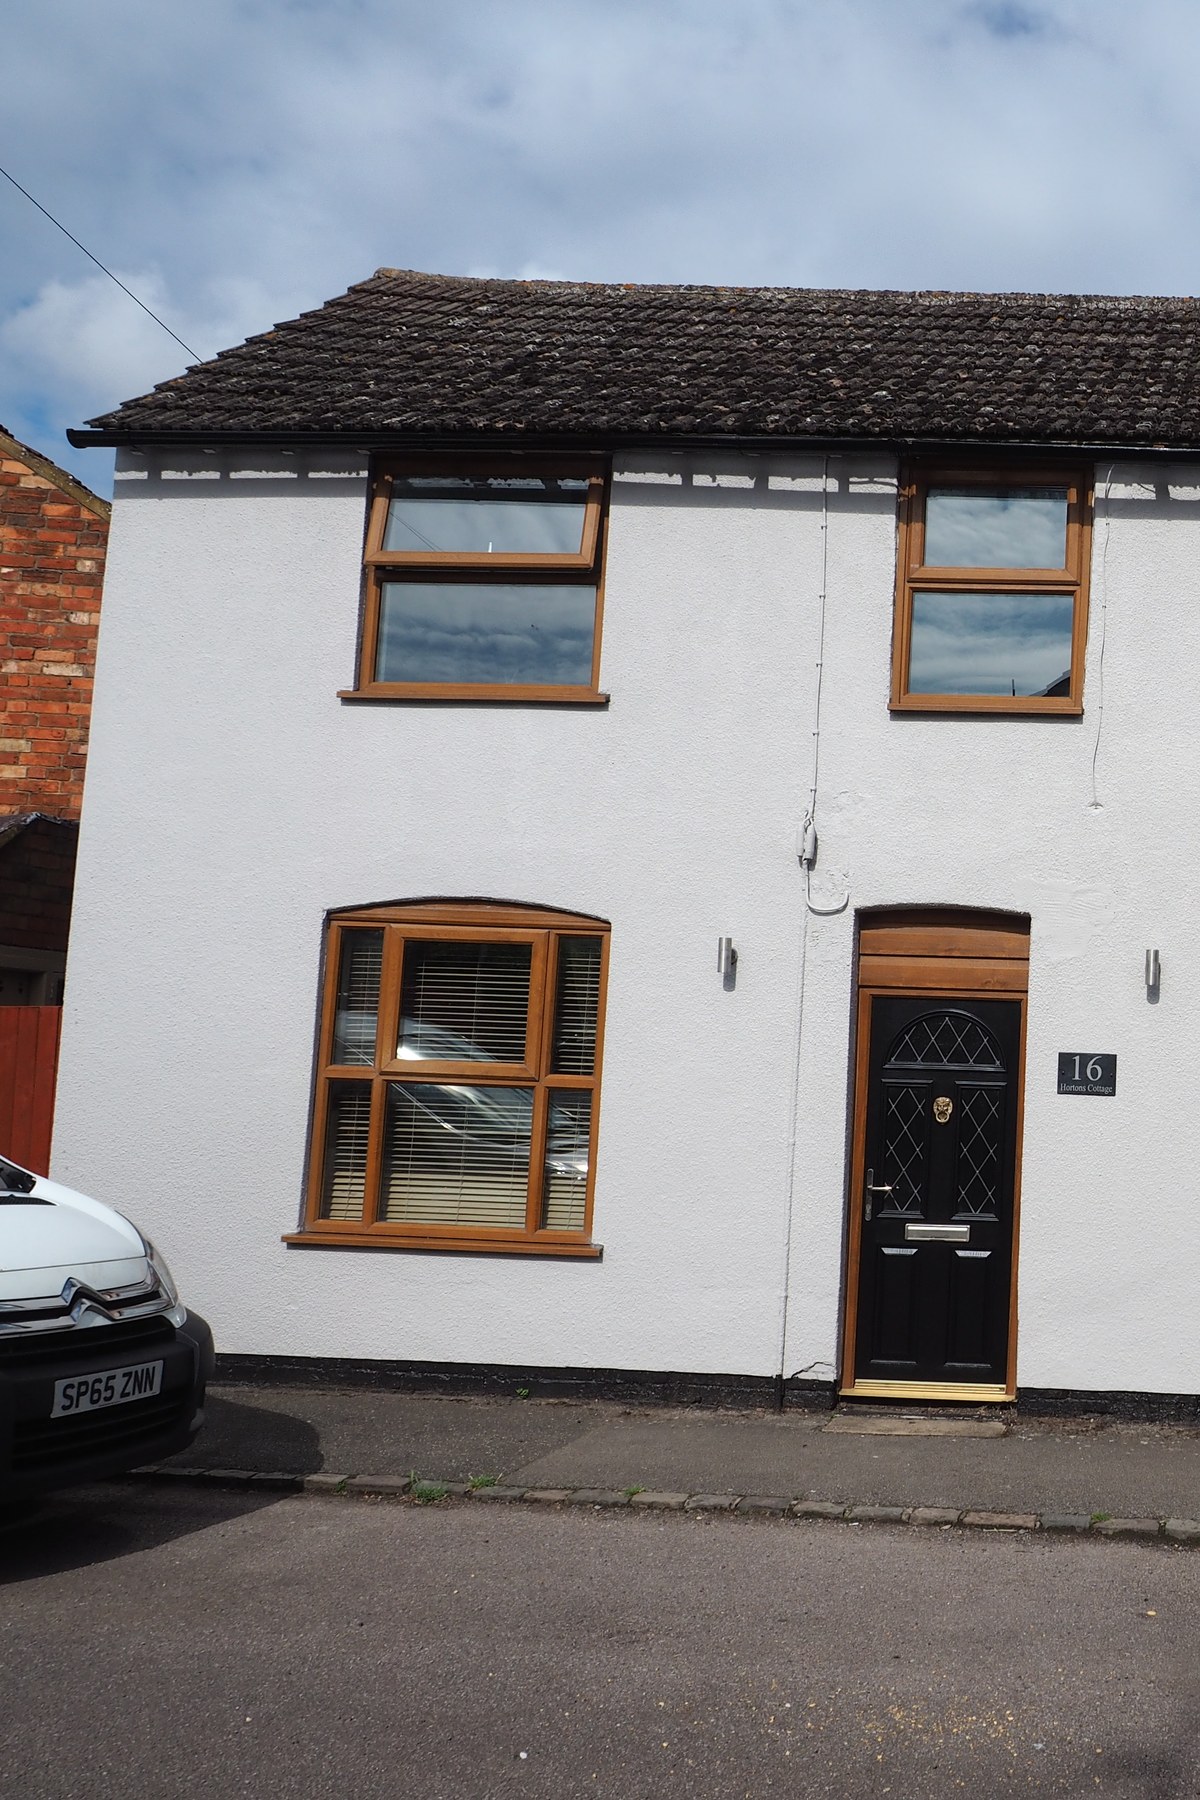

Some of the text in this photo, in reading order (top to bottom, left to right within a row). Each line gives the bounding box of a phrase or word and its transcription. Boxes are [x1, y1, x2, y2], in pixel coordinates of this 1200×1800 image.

[1071, 1055, 1102, 1081] 16
[1060, 1083, 1113, 1095] Hortons Cottage
[61, 1366, 156, 1411] SP65 ZNN
